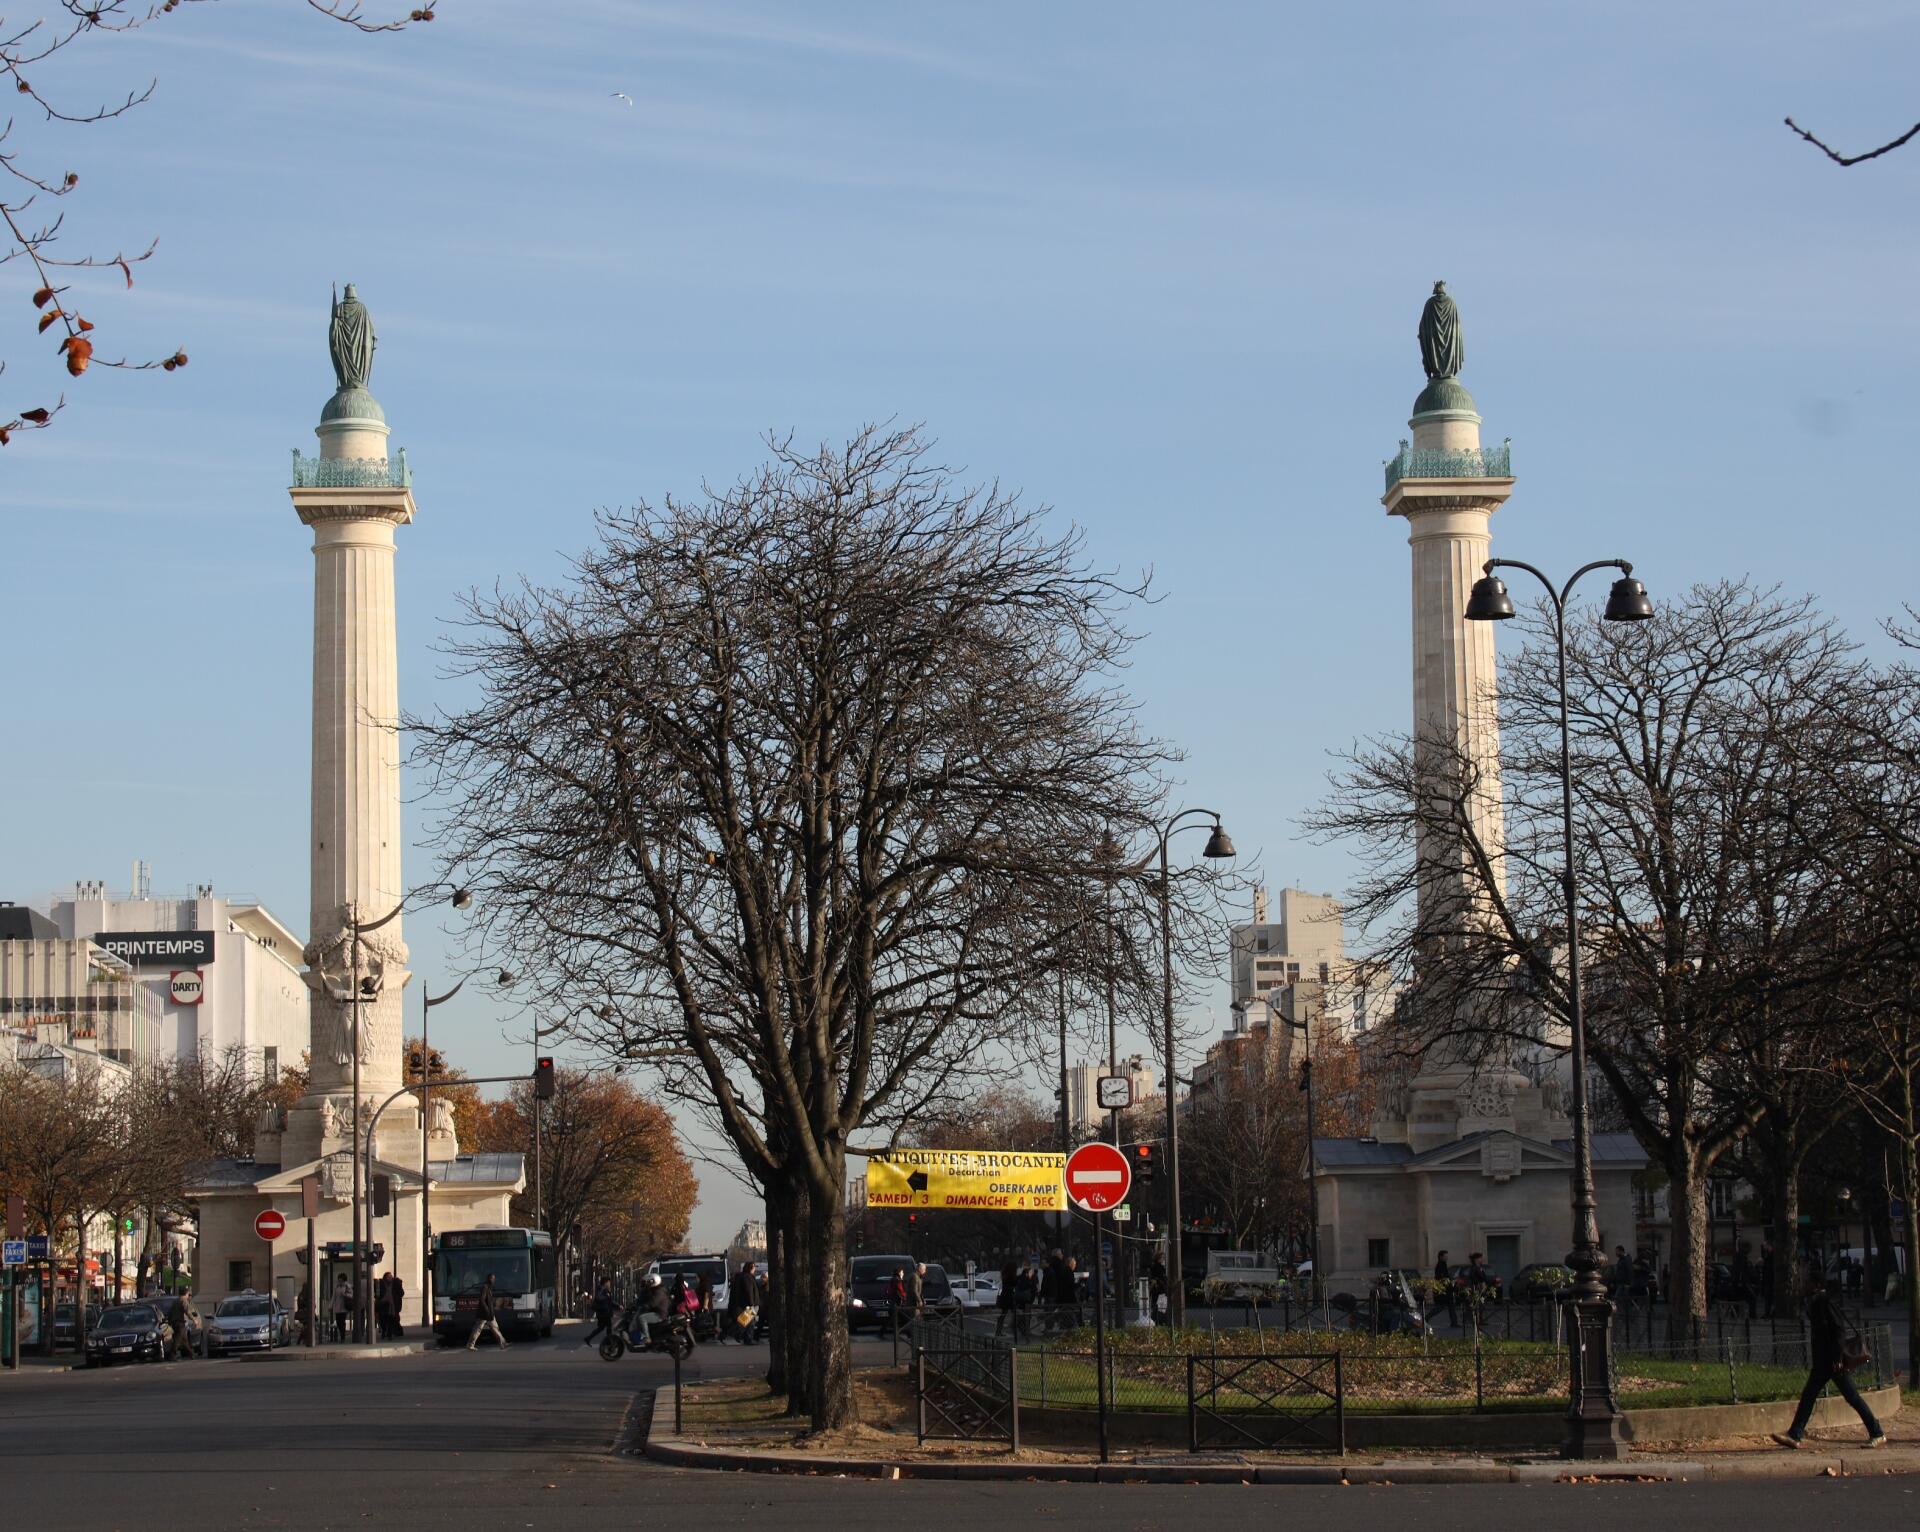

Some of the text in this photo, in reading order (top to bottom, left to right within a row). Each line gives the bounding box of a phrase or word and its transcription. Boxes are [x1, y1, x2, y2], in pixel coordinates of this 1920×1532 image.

[106, 940, 205, 955] PRINTEMPS
[172, 982, 201, 992] DARTY
[989, 1183, 1058, 1194] OBERKAMPF
[869, 1193, 1055, 1207] SAMEDI 3 DIMANCHE 4 DEC
[450, 1235, 465, 1246] 86
[5, 1248, 24, 1256] TAXIS
